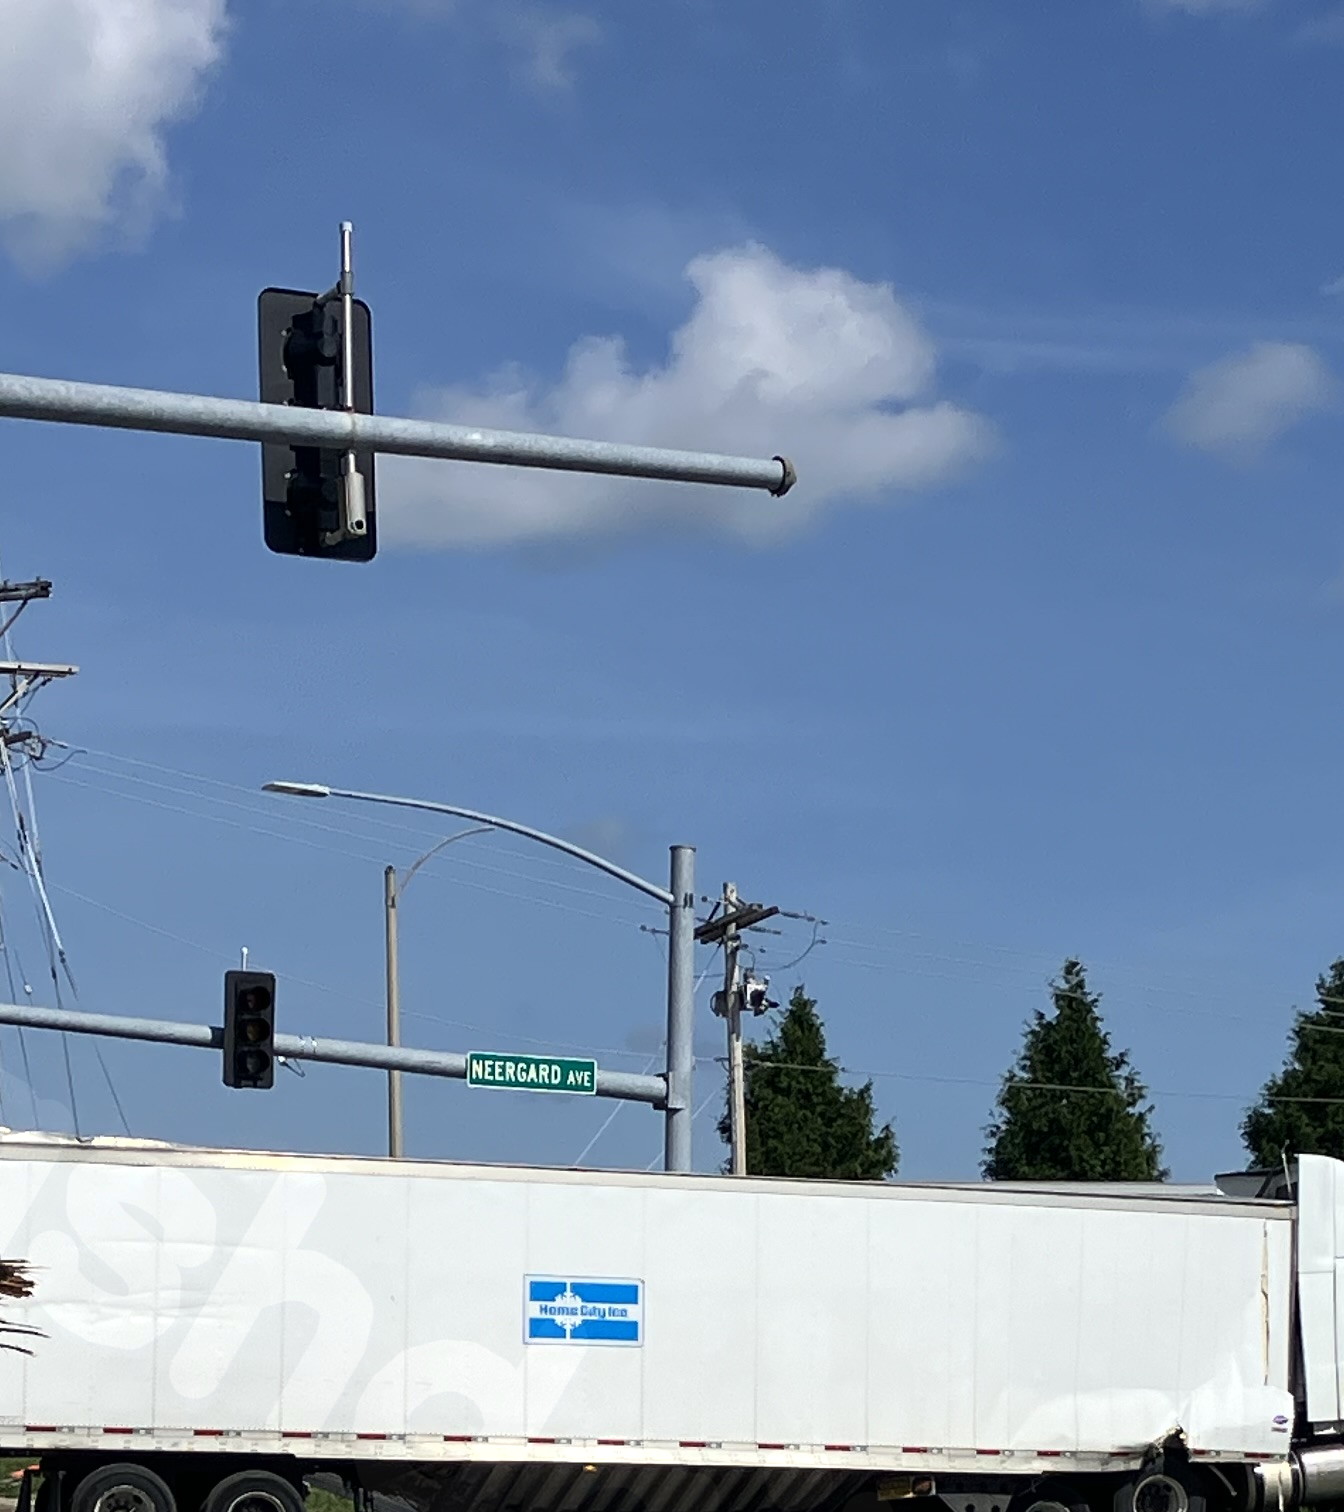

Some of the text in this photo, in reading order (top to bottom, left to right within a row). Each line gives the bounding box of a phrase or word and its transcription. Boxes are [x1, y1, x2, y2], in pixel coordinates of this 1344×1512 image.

[471, 1059, 592, 1087] NEERGARD AVE
[539, 1304, 578, 1316] Home
